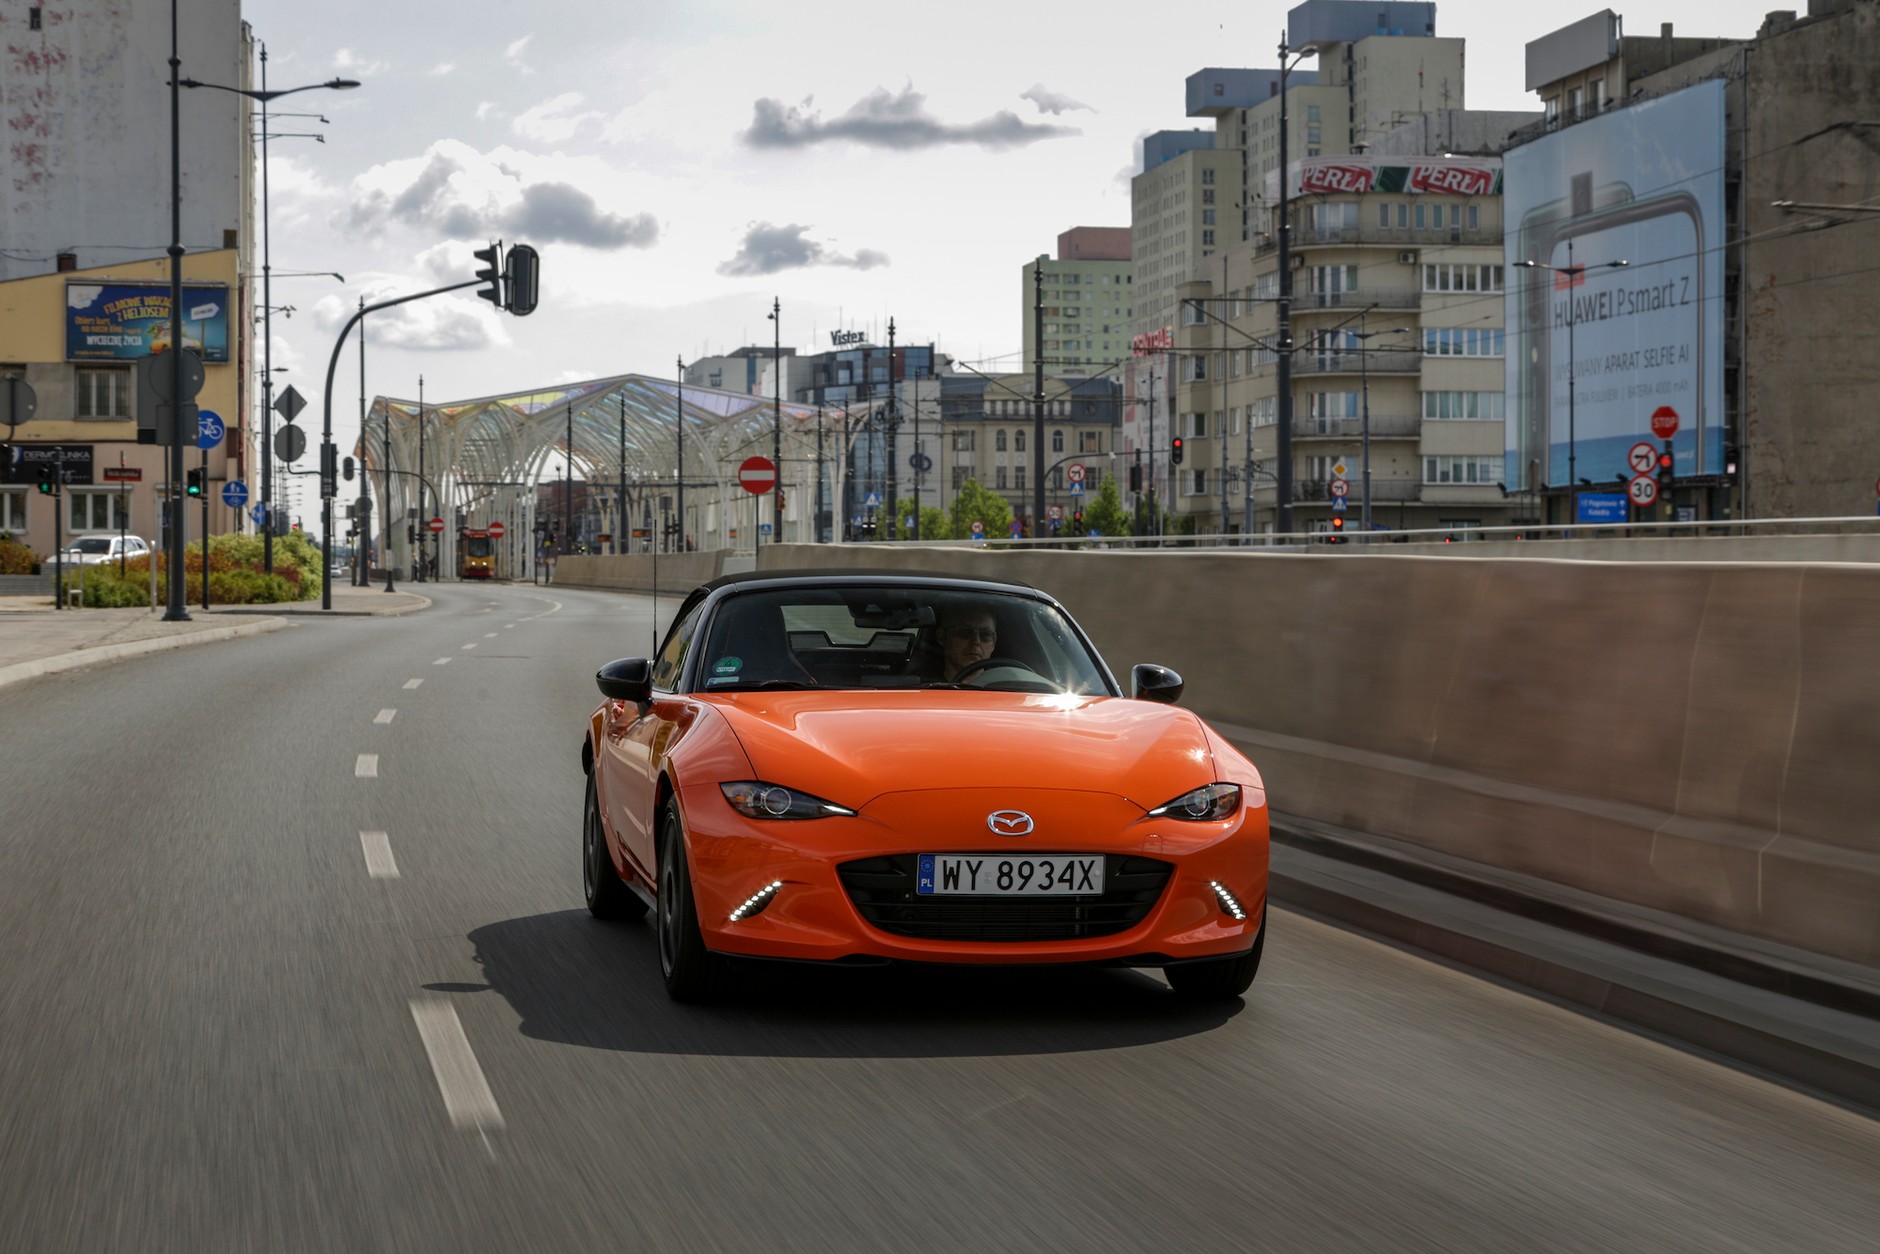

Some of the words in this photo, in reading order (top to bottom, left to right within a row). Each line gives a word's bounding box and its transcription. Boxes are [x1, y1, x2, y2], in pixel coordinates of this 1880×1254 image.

[1303, 166, 1365, 192] PERŁA
[1417, 165, 1490, 194] PERŁA
[103, 296, 142, 315] FILMOWE
[1554, 290, 1613, 329] HUAWEI
[1680, 275, 1690, 305] Z
[830, 329, 865, 346] Vistex
[1604, 351, 1641, 374] APARAT
[1643, 345, 1675, 369] SELFIE
[1654, 417, 1676, 428] STOP
[1633, 483, 1654, 498] 30
[921, 878, 933, 887] PL
[942, 860, 984, 891] WY
[996, 860, 1096, 891] 8934X
